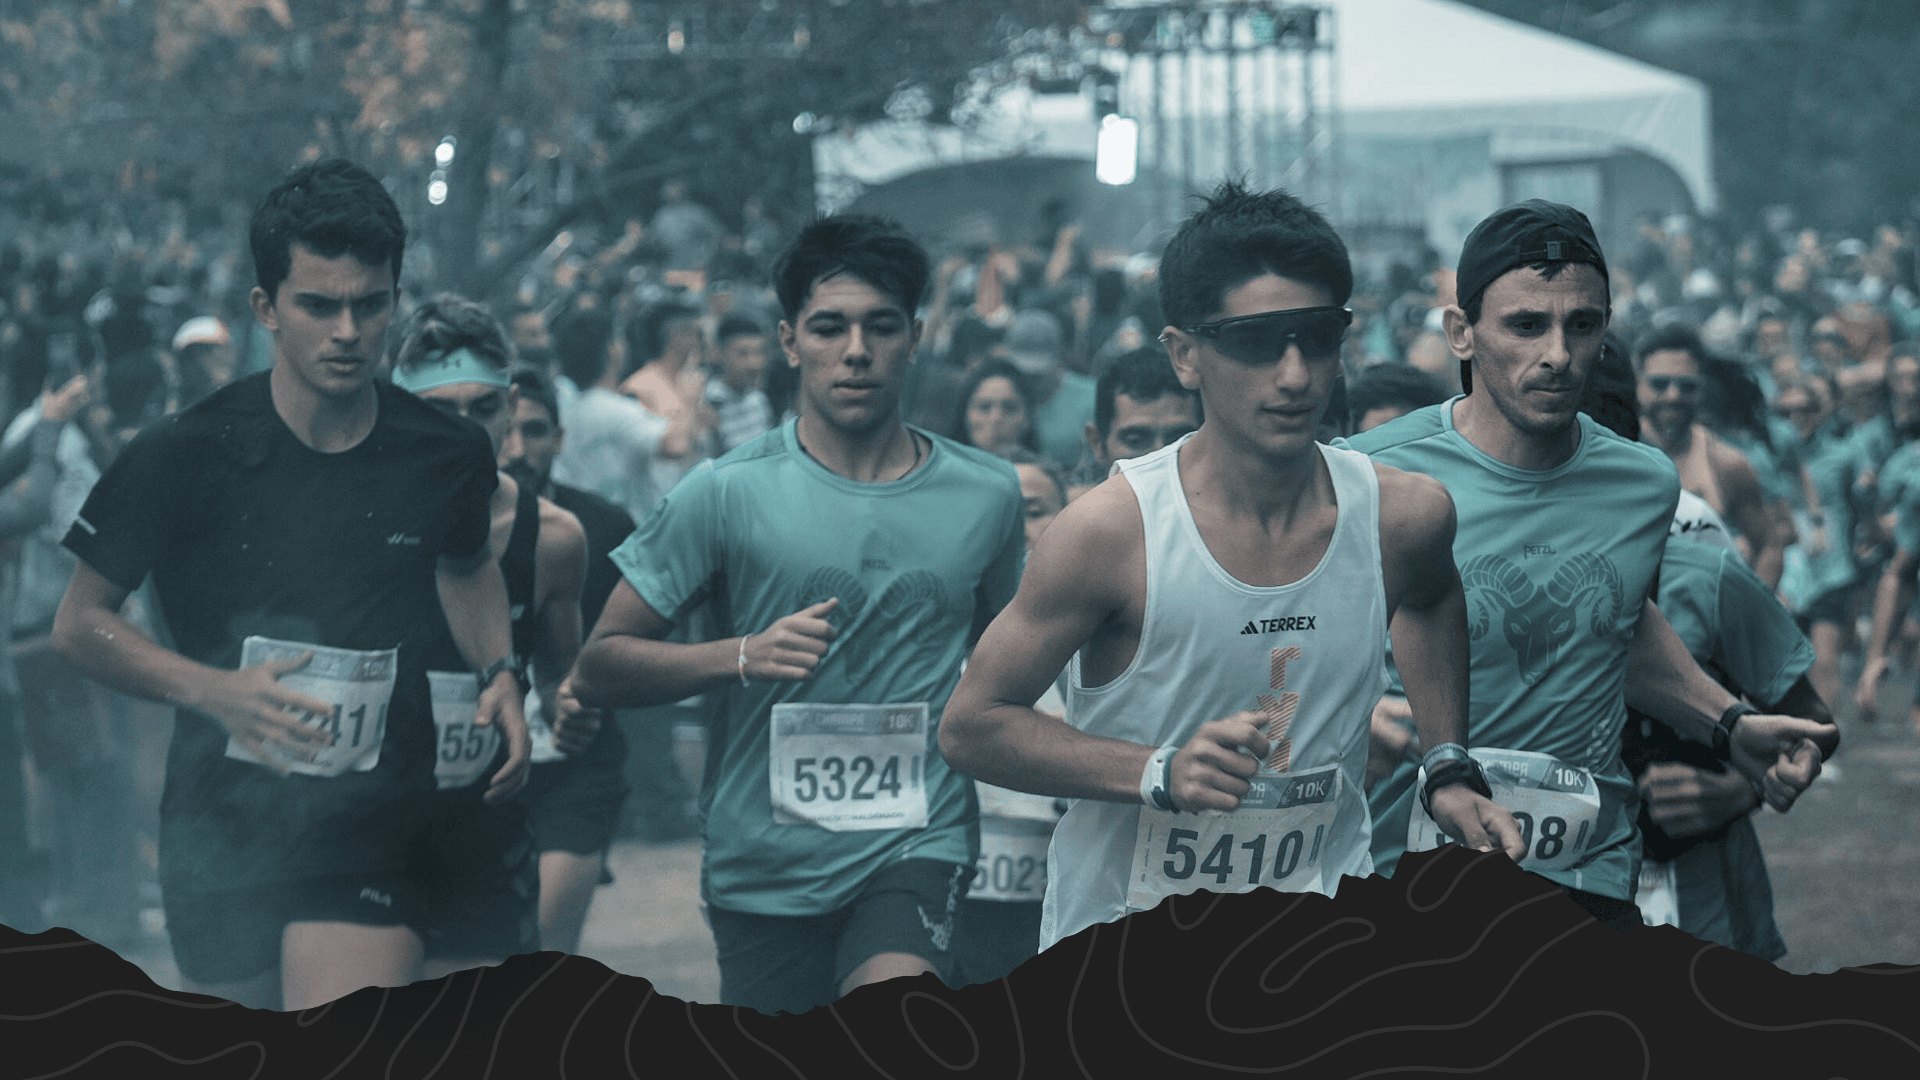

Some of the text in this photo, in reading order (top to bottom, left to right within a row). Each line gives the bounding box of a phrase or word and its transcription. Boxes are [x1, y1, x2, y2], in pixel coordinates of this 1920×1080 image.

[1260, 616, 1317, 633] TERREX
[888, 713, 915, 730] 10K
[437, 722, 484, 762] 55
[794, 755, 901, 803] 5324
[1296, 780, 1327, 799] 10K
[1554, 768, 1585, 788] 10K
[1163, 827, 1304, 884] 5410
[971, 854, 1047, 892] 502
